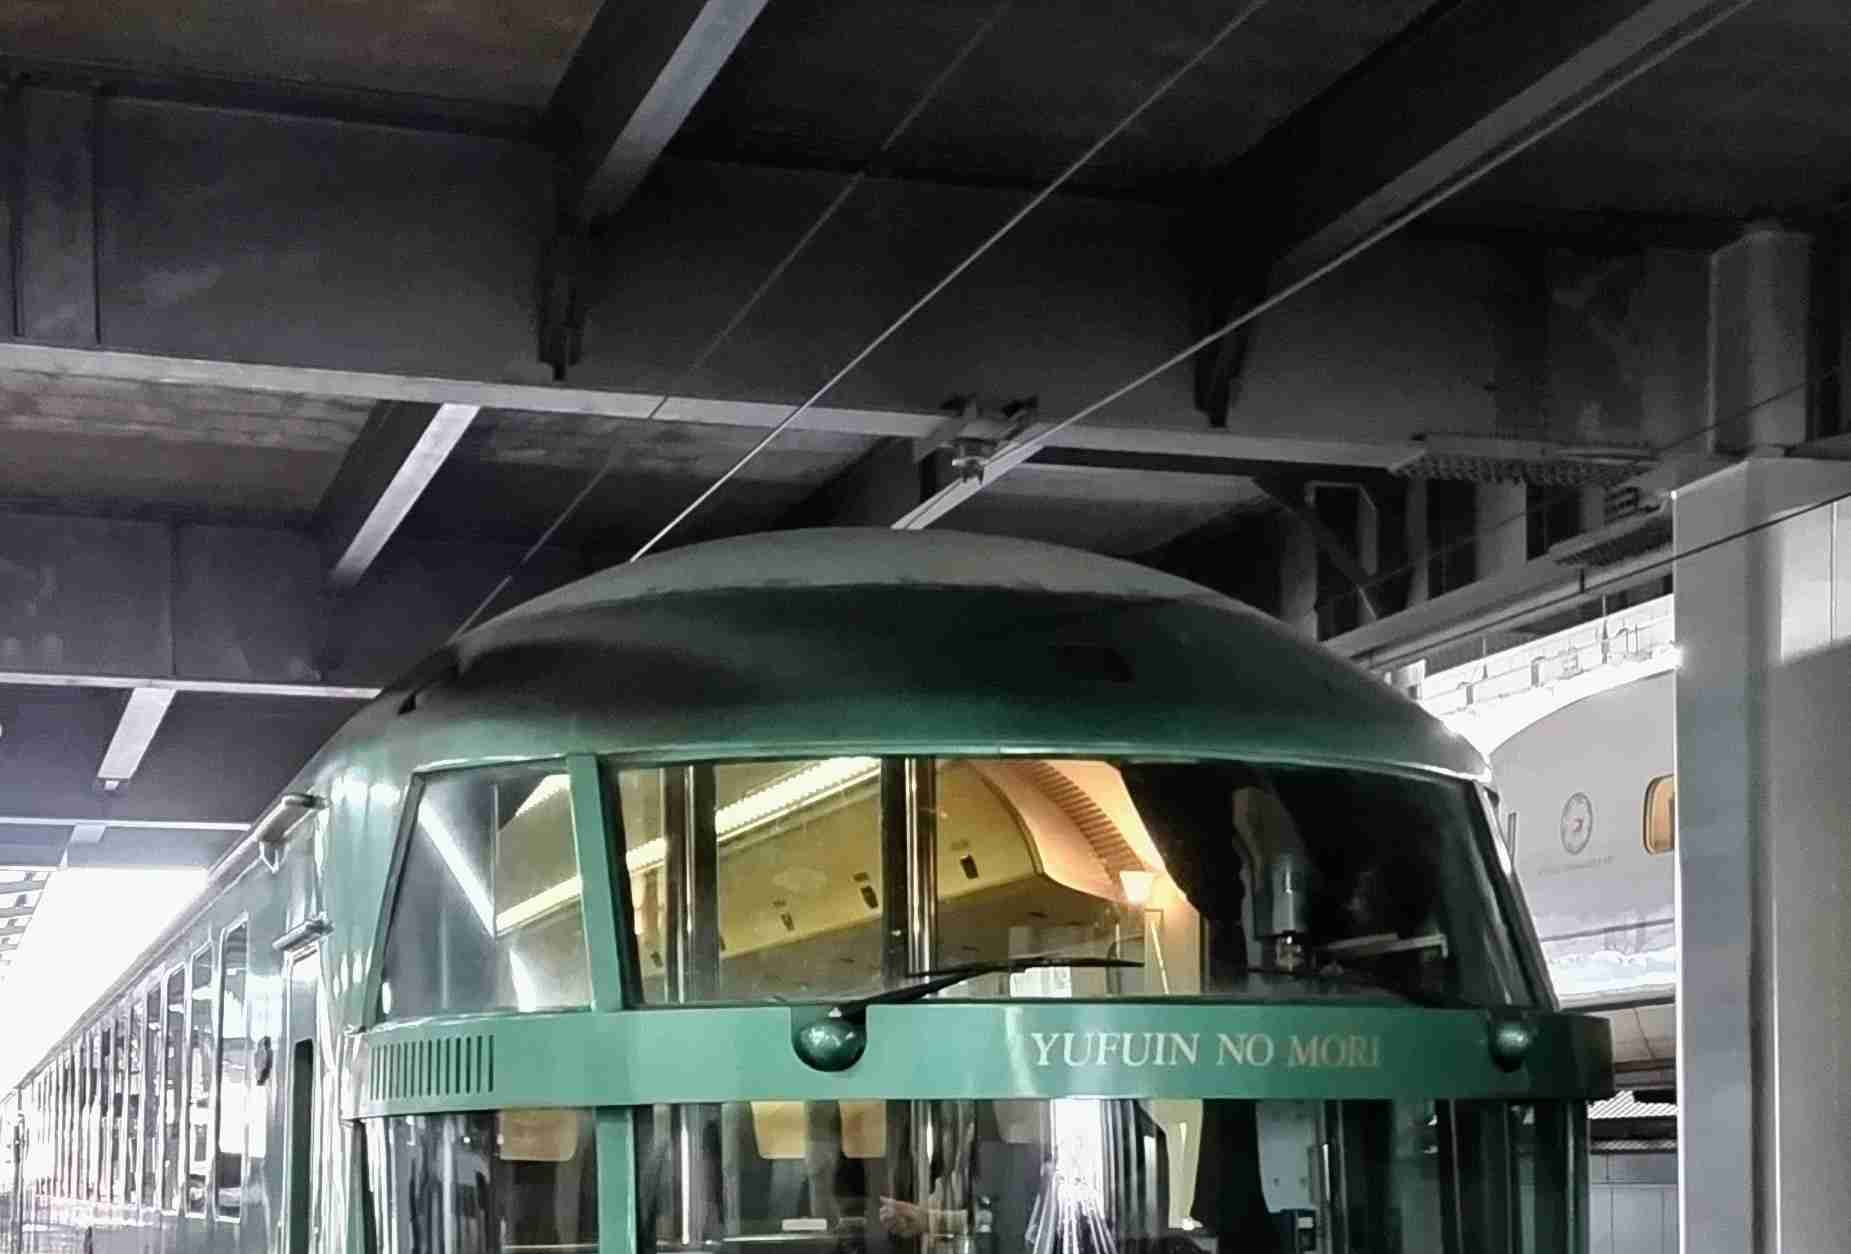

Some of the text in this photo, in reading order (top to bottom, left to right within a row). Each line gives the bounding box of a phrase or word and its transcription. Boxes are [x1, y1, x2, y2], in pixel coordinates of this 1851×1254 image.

[1031, 1032, 1381, 1068] YUFUIN NO MORI
